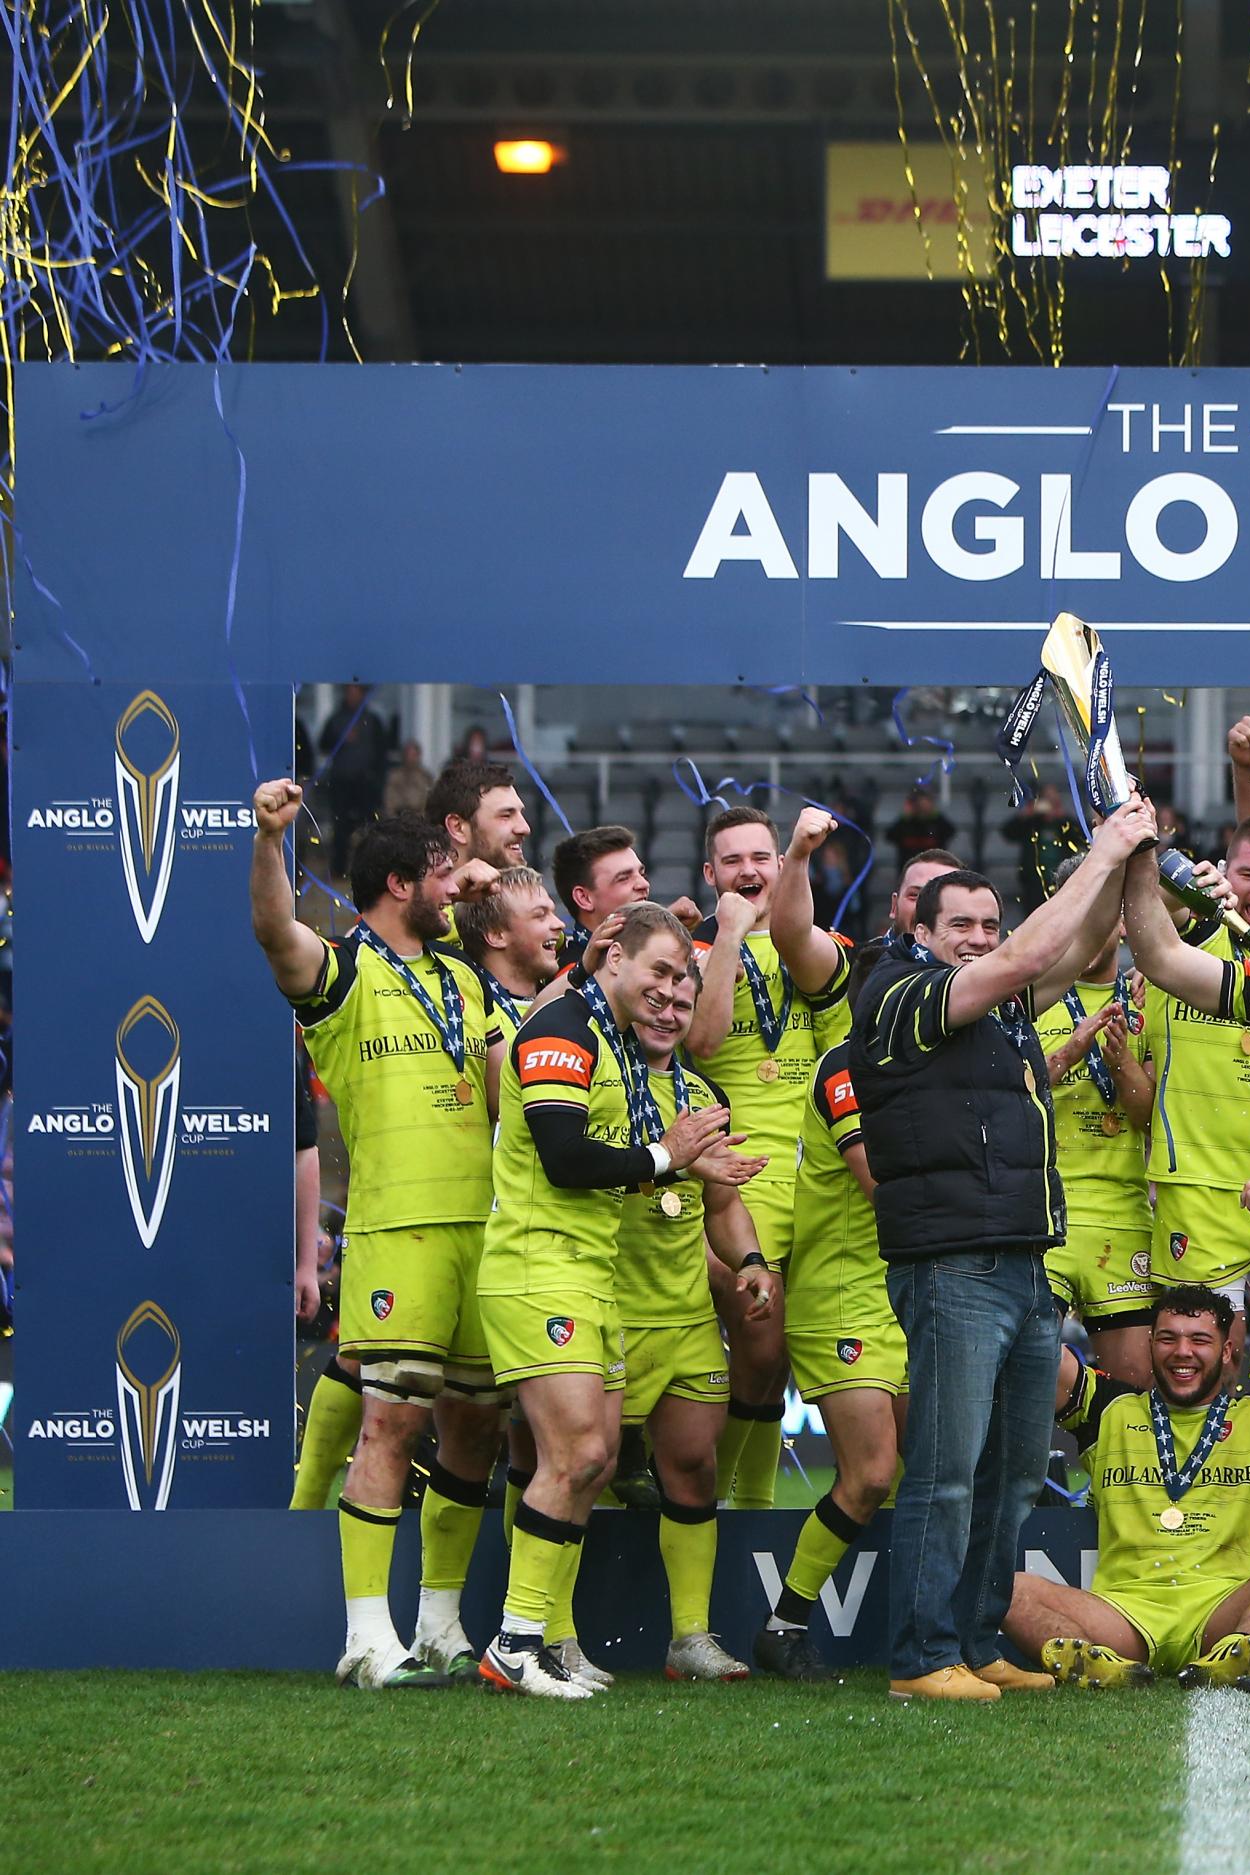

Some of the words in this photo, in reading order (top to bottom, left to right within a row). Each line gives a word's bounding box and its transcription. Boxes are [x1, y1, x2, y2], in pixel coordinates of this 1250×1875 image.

[1012, 165, 1170, 208] EXETER
[1012, 214, 1231, 257] LEICESTER
[1107, 403, 1239, 453] THE
[682, 471, 1239, 582] ANGLO
[1010, 710, 1032, 747] WELSH
[91, 798, 112, 808] THE
[27, 808, 114, 828] ANGLO
[181, 809, 258, 828] WELS
[181, 829, 204, 839] CUP
[359, 1032, 437, 1062] HOLLAND
[524, 1051, 586, 1074] STIHL
[835, 1082, 855, 1104] ST
[92, 1104, 113, 1113] THE
[28, 1114, 115, 1133] ANGLO
[182, 1114, 270, 1133] WELSH
[181, 1134, 204, 1144] CUP
[92, 1409, 113, 1418] THE
[28, 1420, 115, 1438] ANGLO
[182, 1420, 270, 1438] WELSH
[182, 1440, 205, 1449] CUP
[1102, 1465, 1165, 1488] HOLLAN
